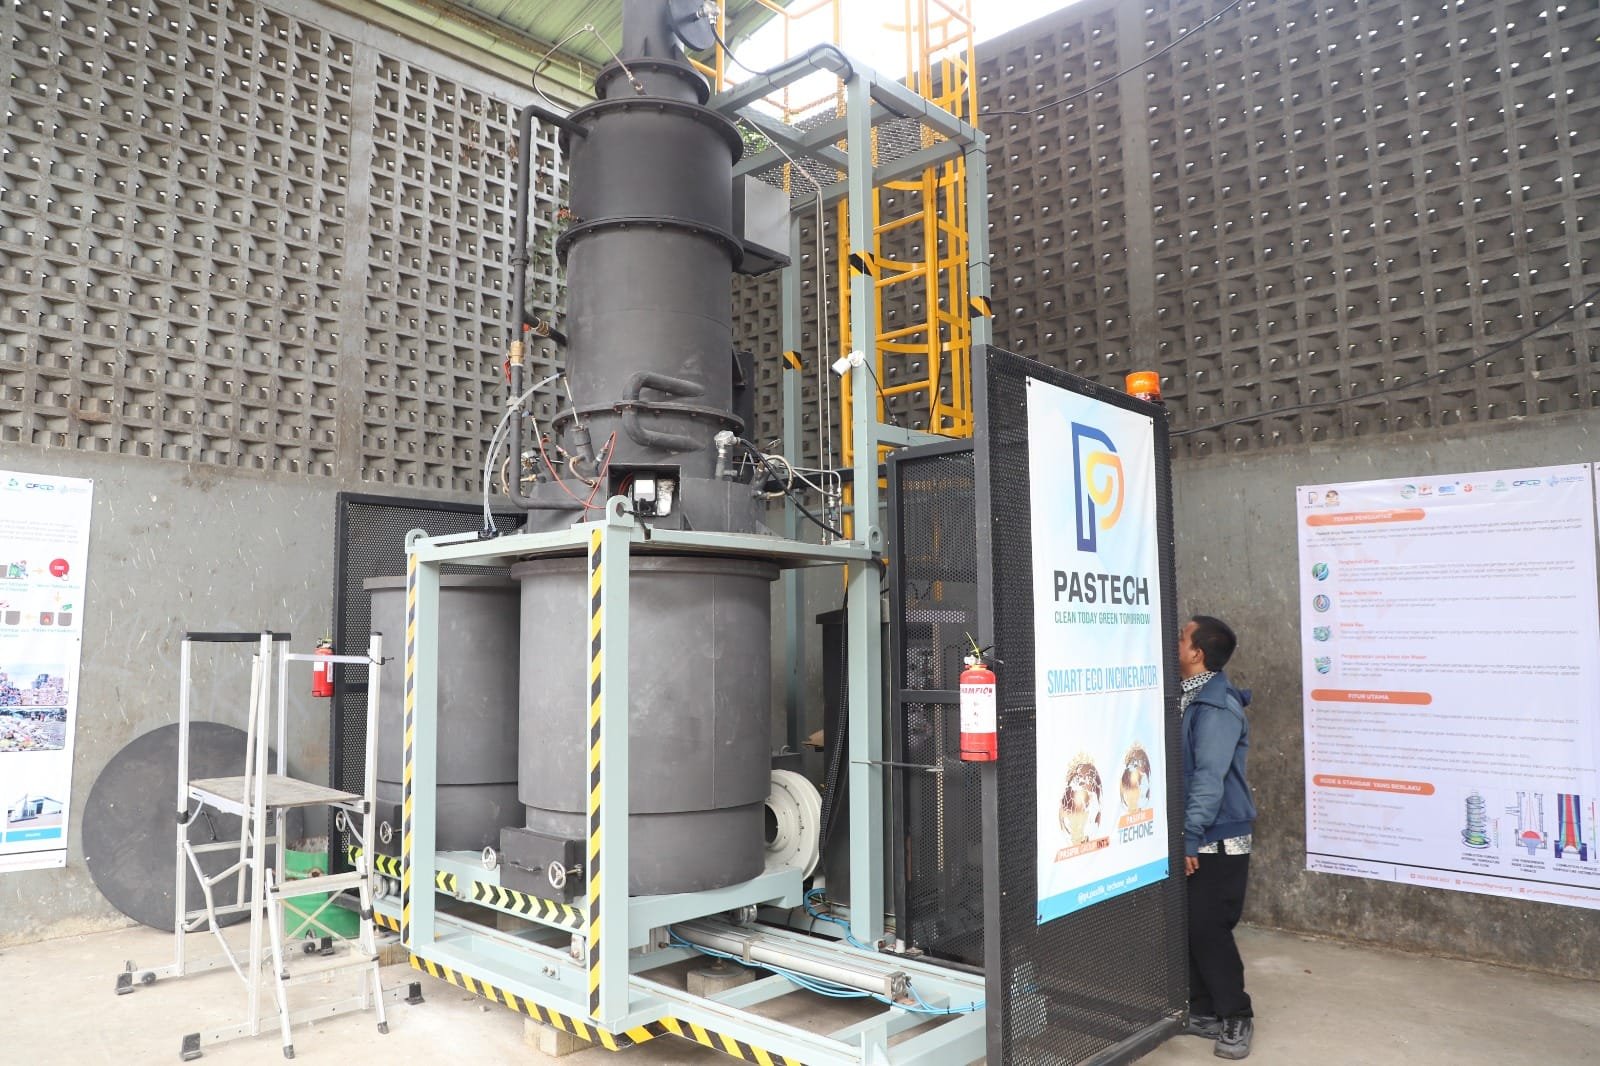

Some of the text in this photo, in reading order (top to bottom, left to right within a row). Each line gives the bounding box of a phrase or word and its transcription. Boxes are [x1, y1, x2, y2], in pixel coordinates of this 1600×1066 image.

[1053, 570, 1149, 605] PASTECH
[1054, 611, 1151, 625] CLEAN TODAY GREEN TOMORROW
[1047, 664, 1158, 694] SMART ECO INCINERATOR
[1119, 821, 1154, 844] TECHONE
